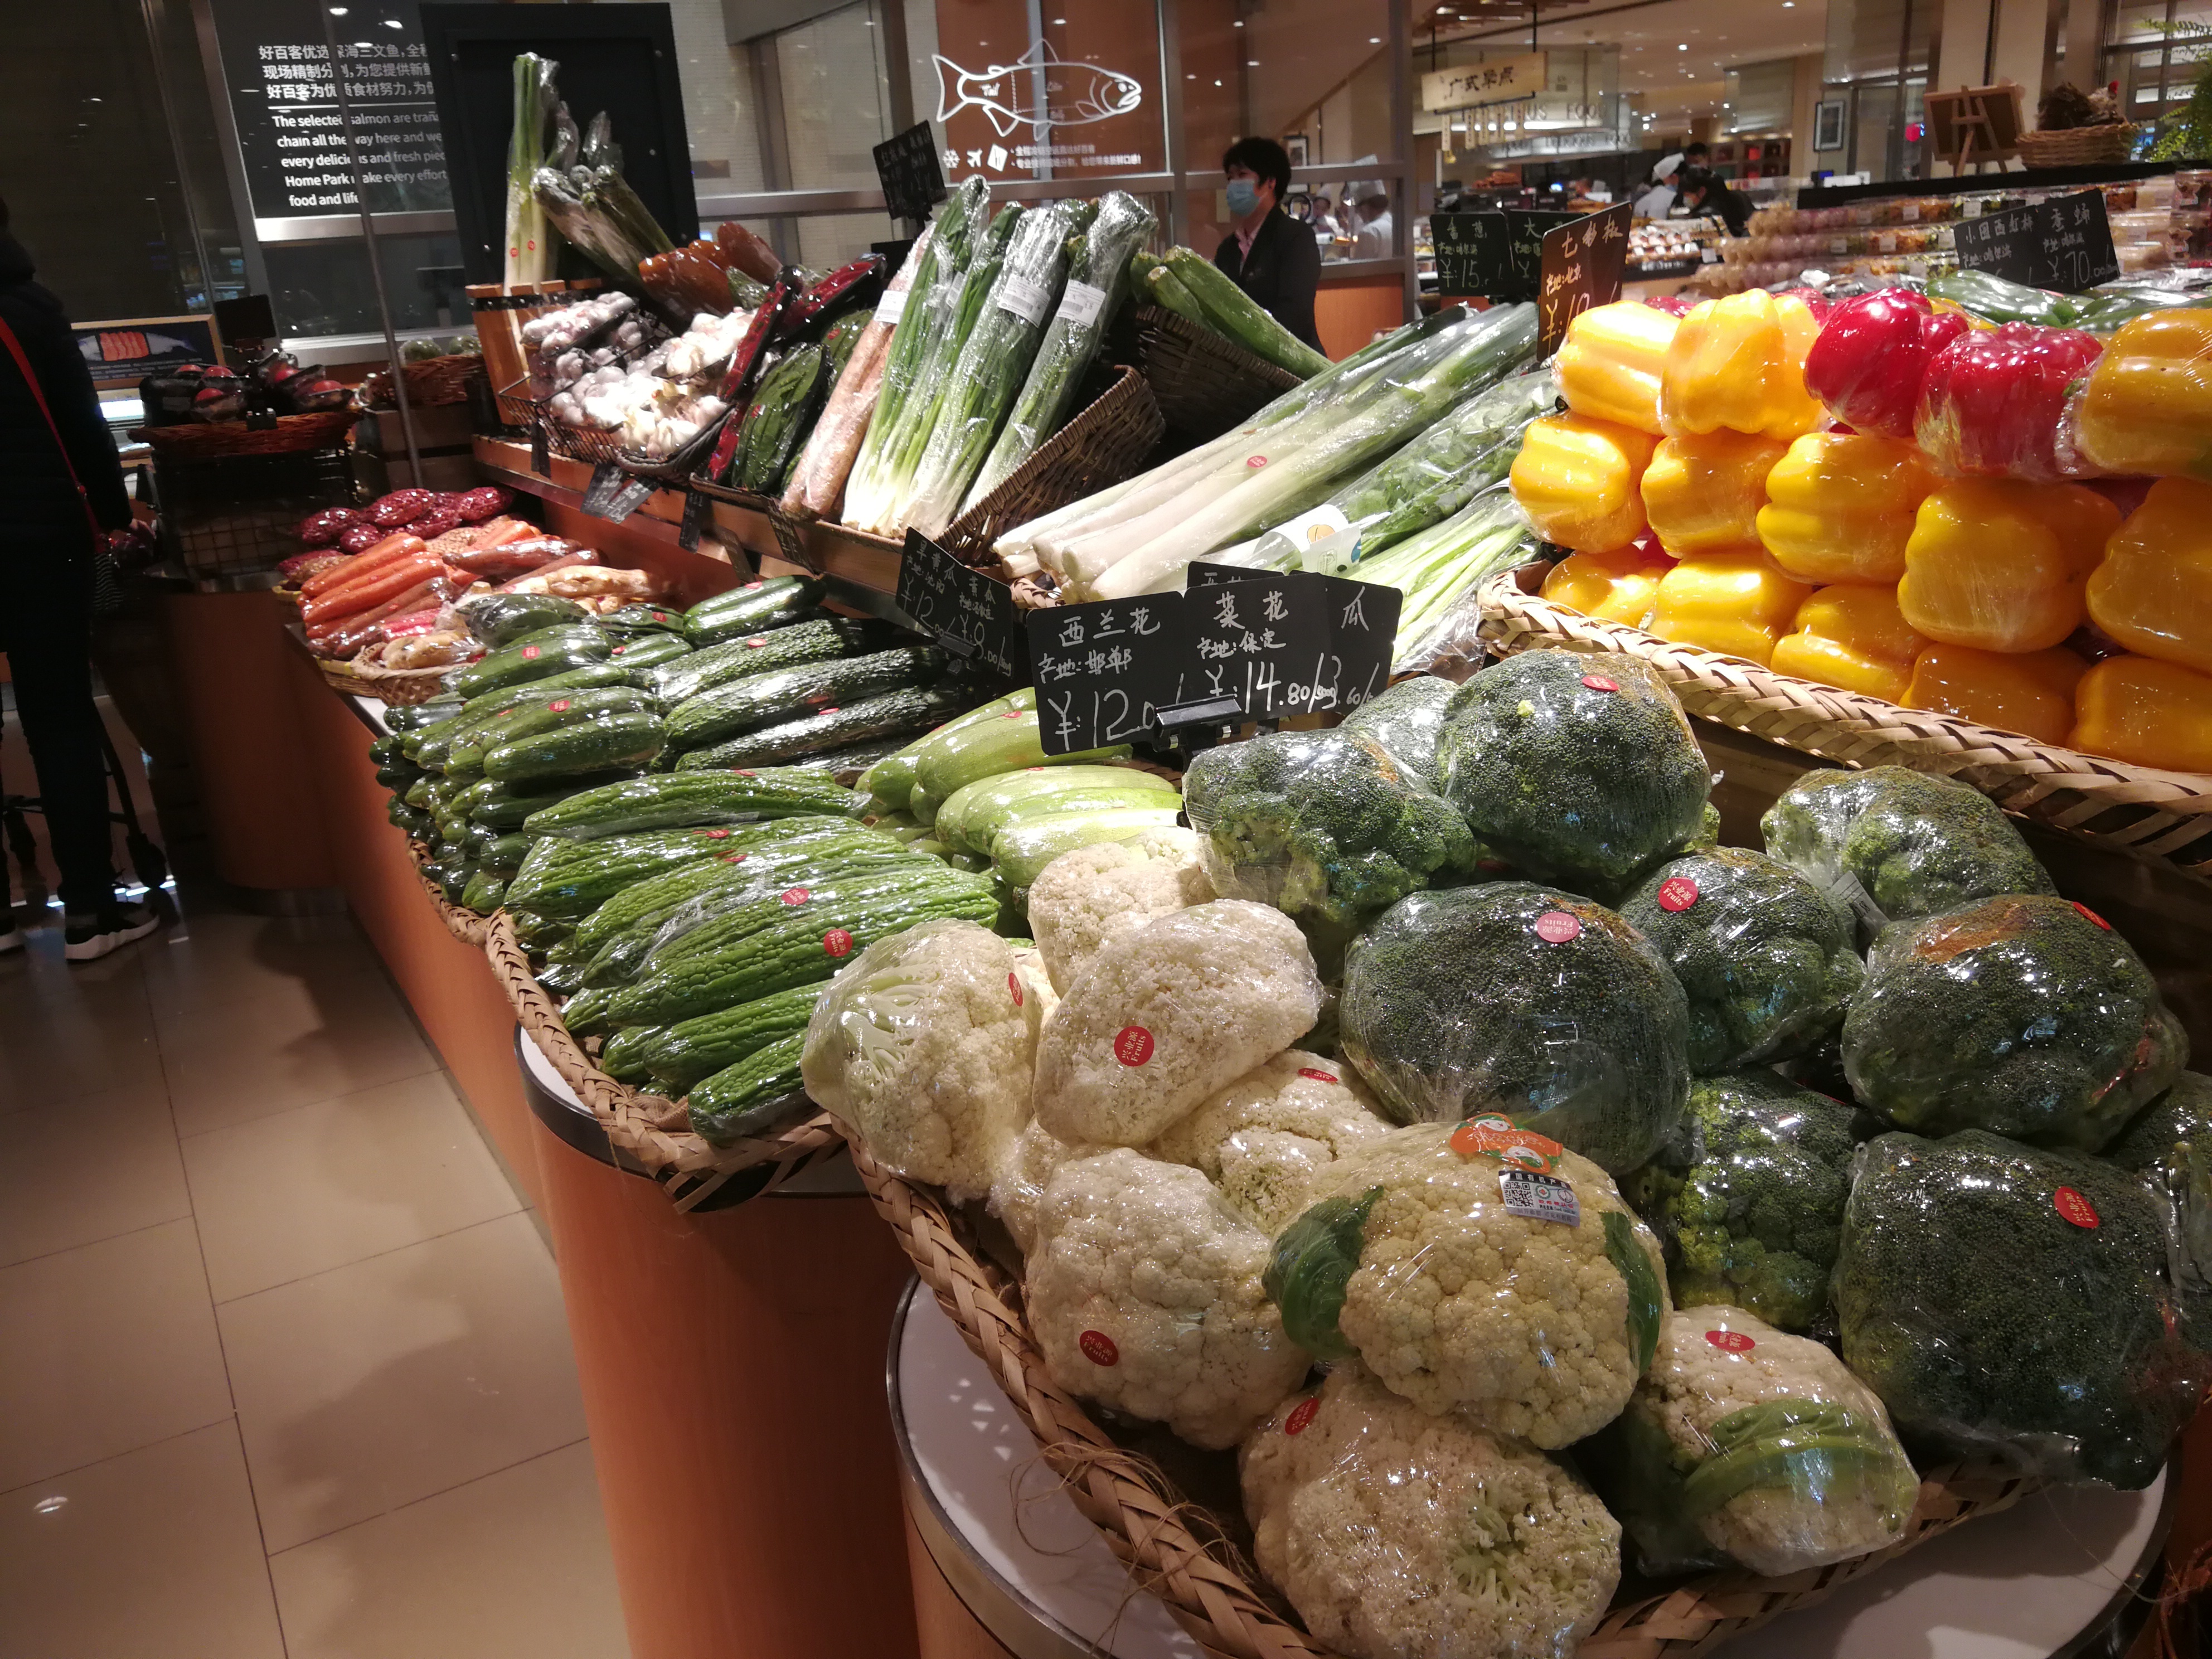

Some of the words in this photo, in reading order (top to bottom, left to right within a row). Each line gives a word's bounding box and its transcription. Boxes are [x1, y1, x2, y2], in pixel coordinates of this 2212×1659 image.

[271, 115, 297, 127] The
[393, 114, 411, 123] are
[276, 135, 311, 147] chain
[312, 134, 327, 146] all
[328, 134, 347, 145] the
[375, 133, 401, 144] here
[403, 132, 424, 143] and
[281, 157, 314, 169] every
[370, 151, 391, 164] and
[394, 151, 421, 163] fresh
[285, 176, 322, 187] Home
[322, 173, 350, 186] Park
[384, 172, 415, 183] every
[418, 169, 448, 181] effort
[289, 193, 317, 207] food
[318, 193, 342, 206] and
[1213, 590, 1288, 629] 菜花
[1059, 607, 1161, 647] 西兰花
[1663, 887, 1684, 906] Fruits
[1545, 919, 1573, 928] Fruits
[829, 933, 838, 953] Fruits
[1131, 1035, 1146, 1062] Fruits
